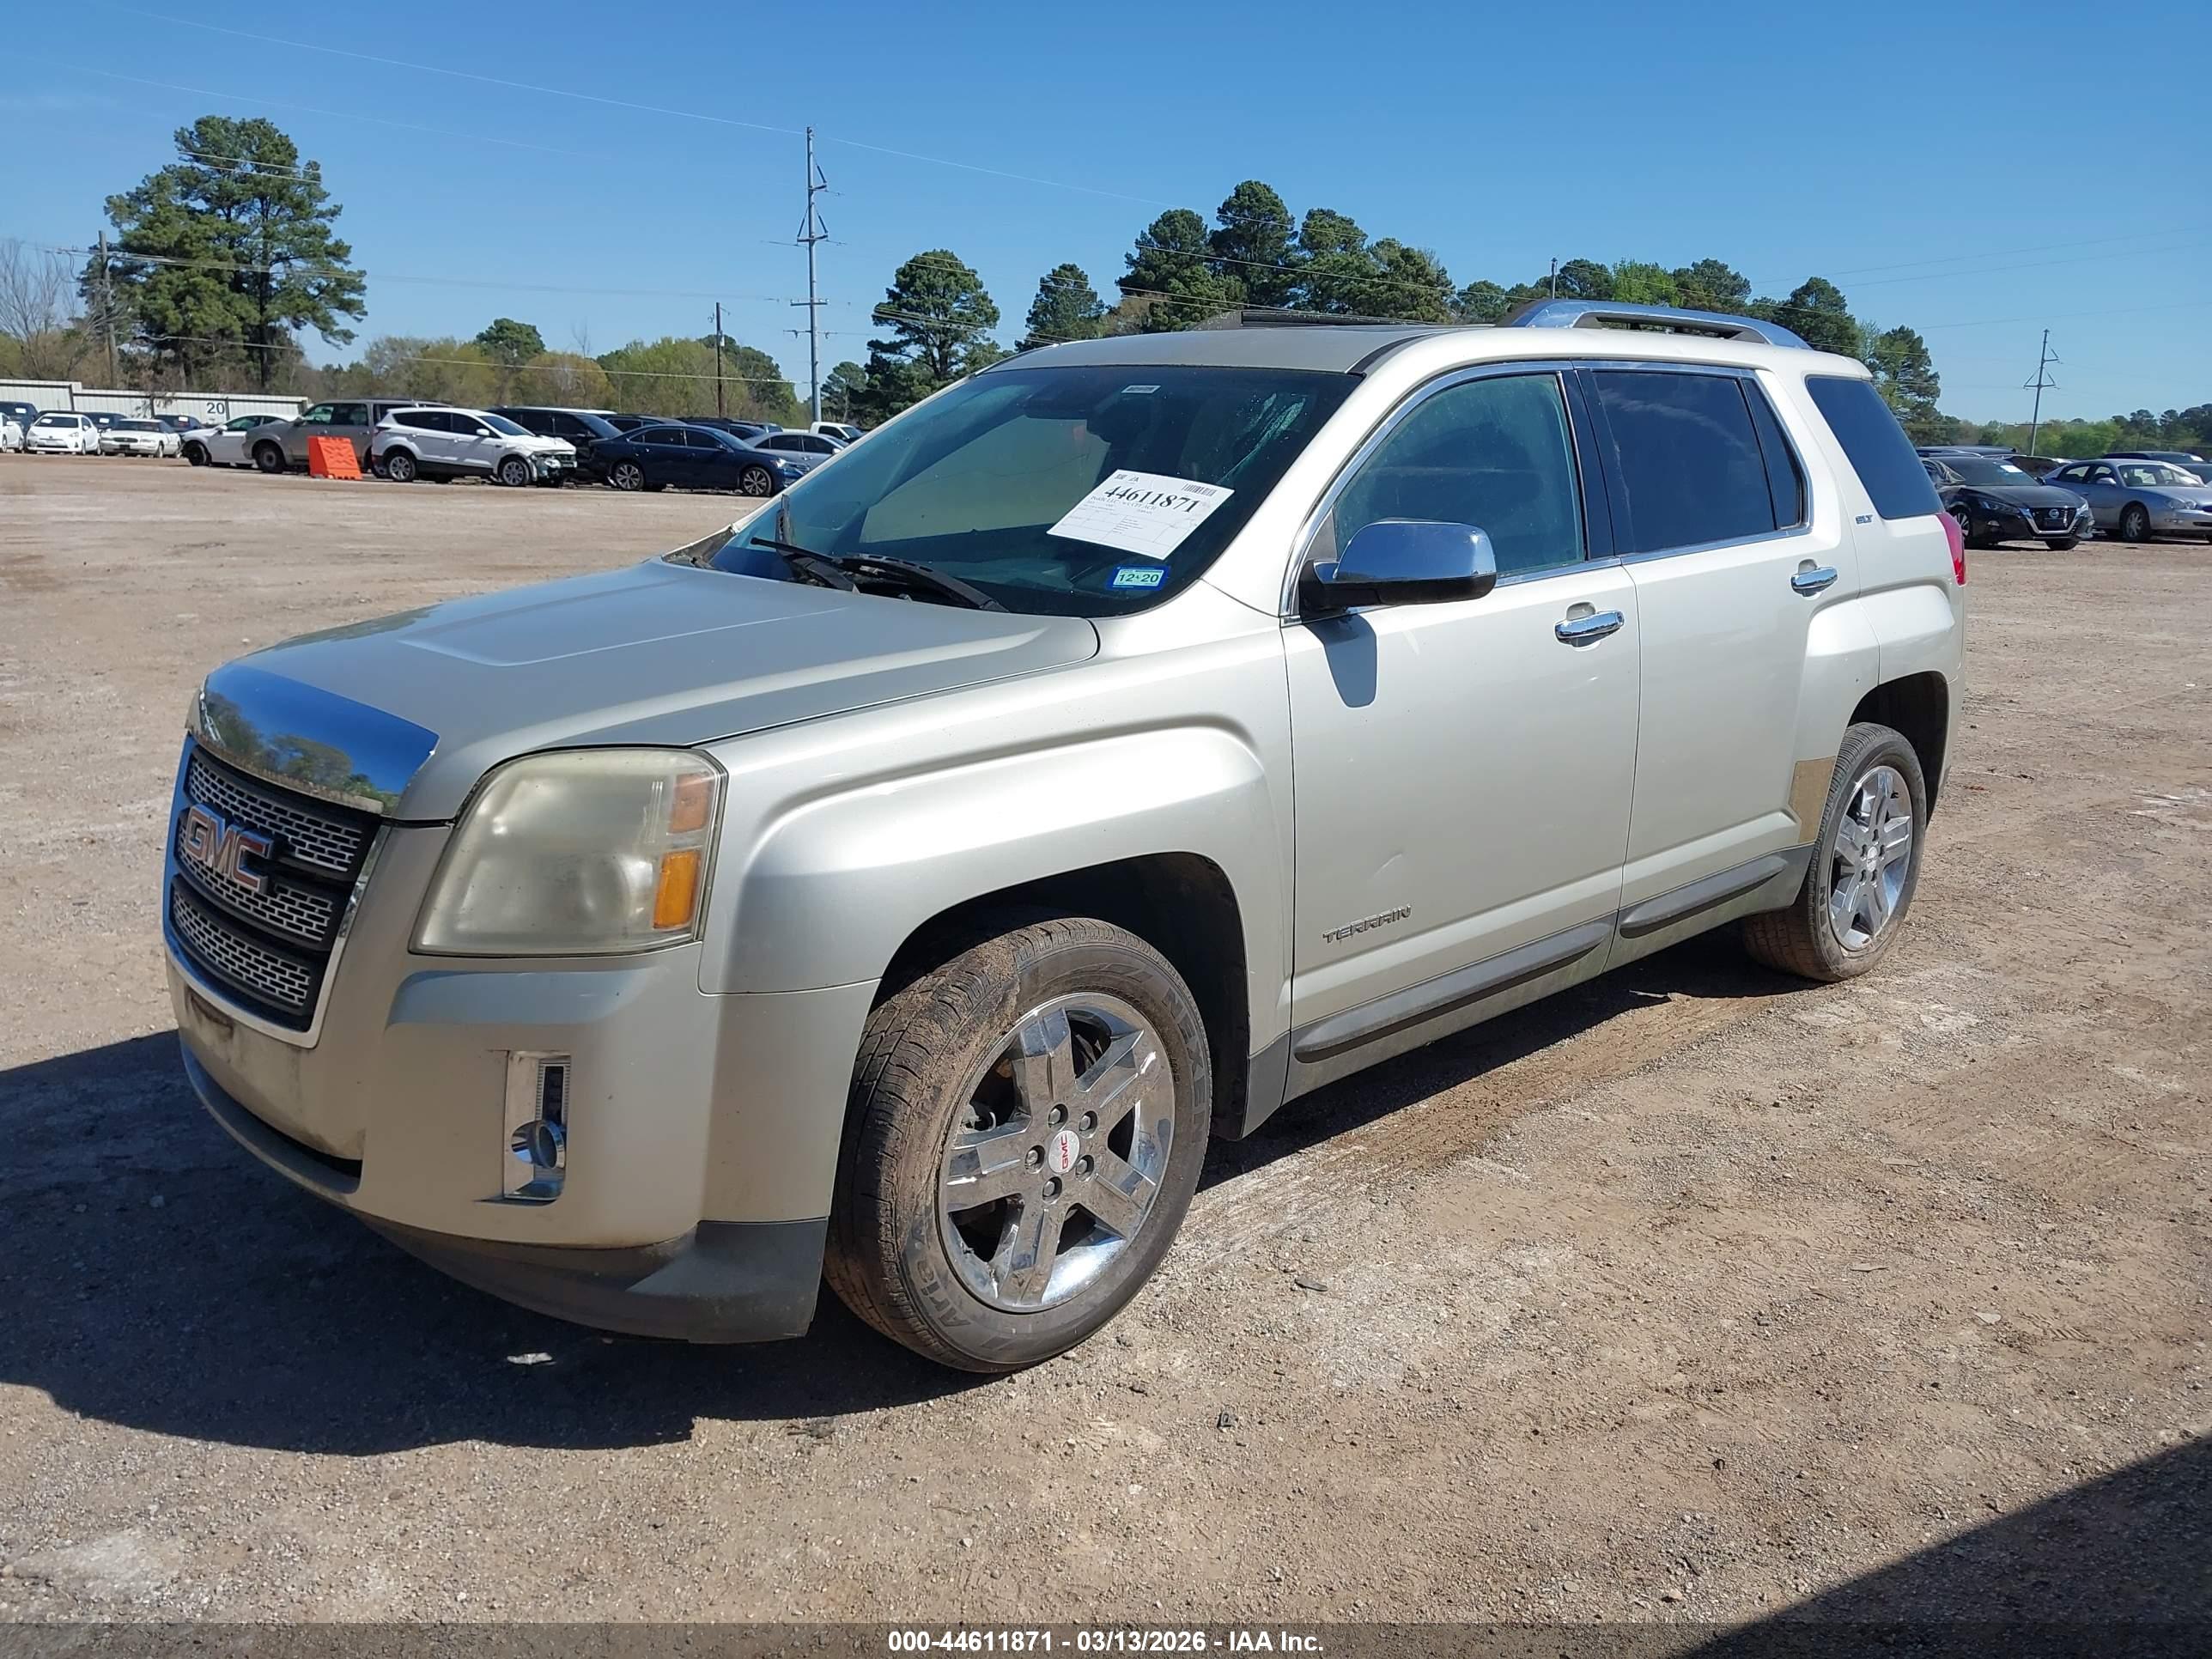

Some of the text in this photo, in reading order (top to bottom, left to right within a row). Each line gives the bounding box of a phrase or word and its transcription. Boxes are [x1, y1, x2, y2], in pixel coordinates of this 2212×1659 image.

[206, 402, 225, 415] 20
[1104, 486, 1202, 514] 44611871
[185, 803, 274, 892] GMC
[1322, 903, 1413, 944] TERRAIN
[1060, 1133, 1069, 1170] GMC
